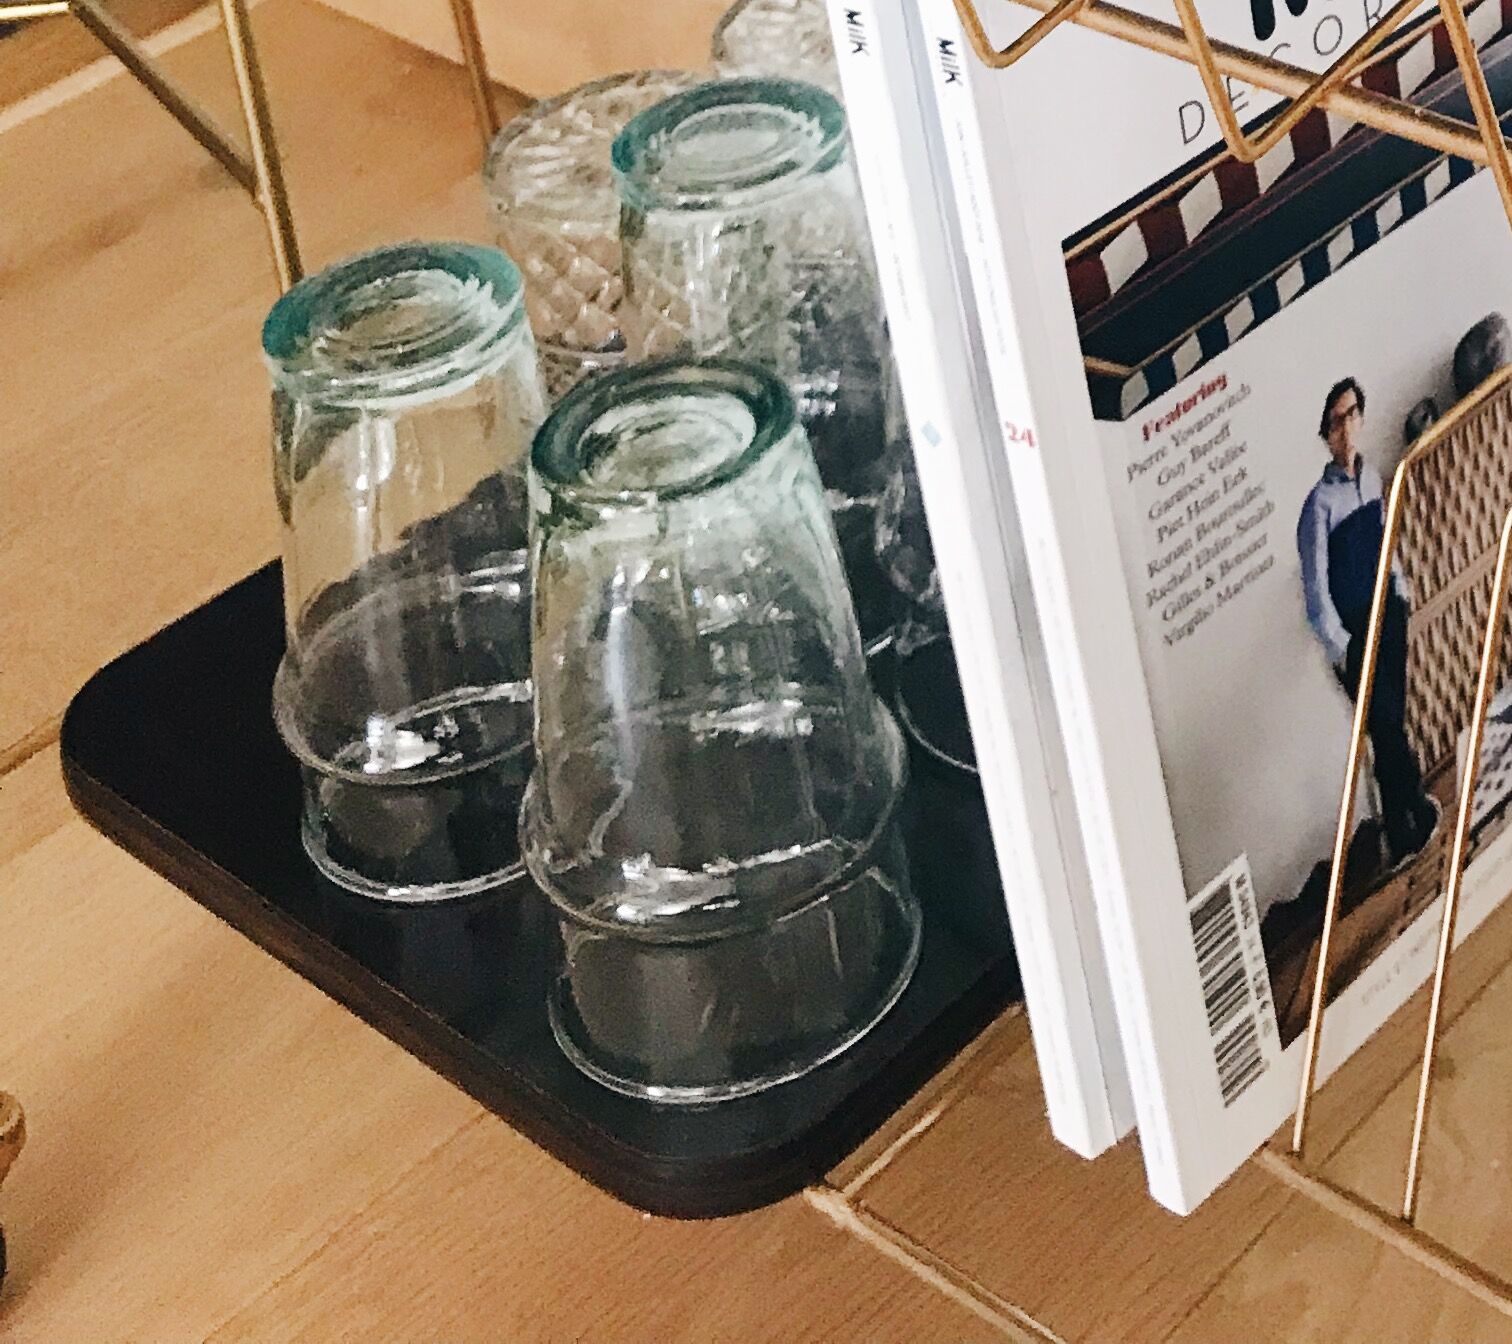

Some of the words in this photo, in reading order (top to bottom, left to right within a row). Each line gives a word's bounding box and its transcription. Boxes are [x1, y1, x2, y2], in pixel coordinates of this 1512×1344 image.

[1142, 374, 1228, 442] Featuring
[1005, 421, 1036, 448] 24
[1127, 446, 1167, 483] Pierre
[1158, 459, 1185, 486] Guy
[1148, 473, 1205, 520] Garance
[1158, 516, 1184, 543] Piet
[1187, 489, 1220, 521] Hein
[1147, 538, 1193, 578] Ronan
[1146, 561, 1192, 608] Rachel
[1162, 585, 1201, 621] Gilles
[1205, 576, 1216, 590] &
